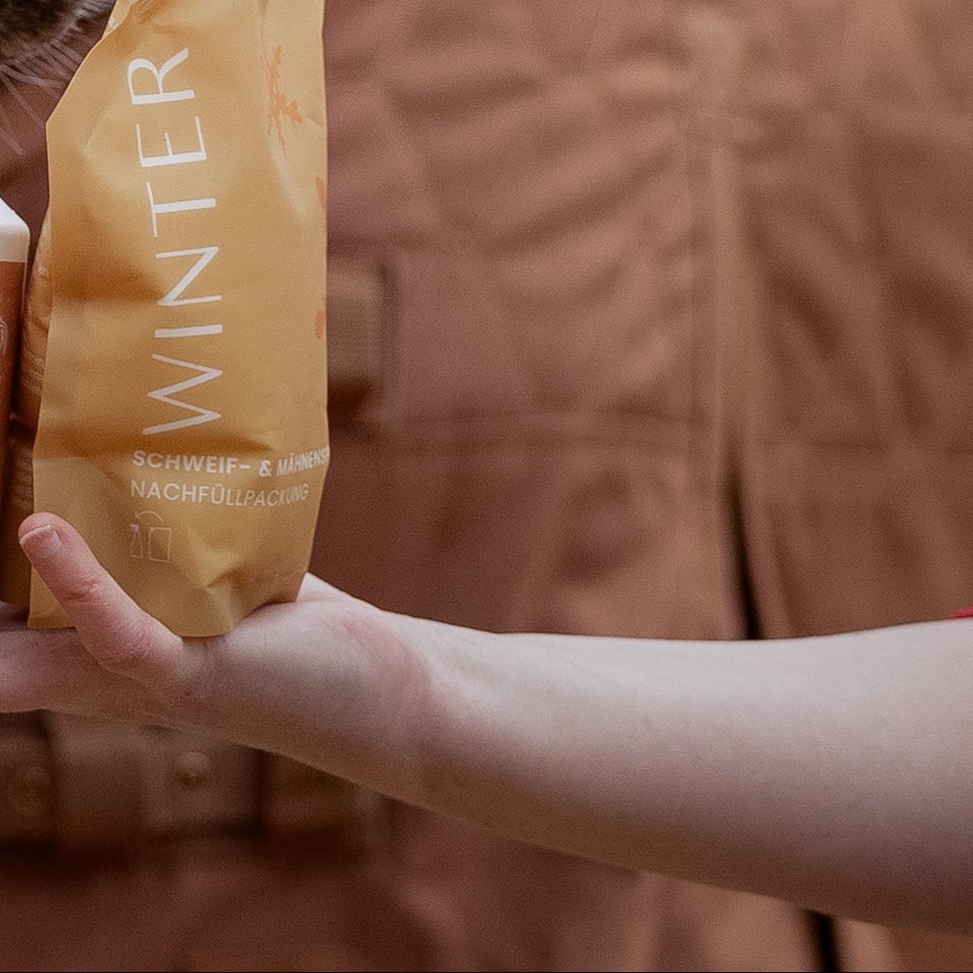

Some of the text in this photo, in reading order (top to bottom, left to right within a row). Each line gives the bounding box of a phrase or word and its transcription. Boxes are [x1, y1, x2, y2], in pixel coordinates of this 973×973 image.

[127, 46, 224, 436] WINTER
[132, 450, 252, 475] SCHWEIF-
[258, 459, 273, 477] &
[130, 479, 310, 507] NACHFÜLLPACKUNG
